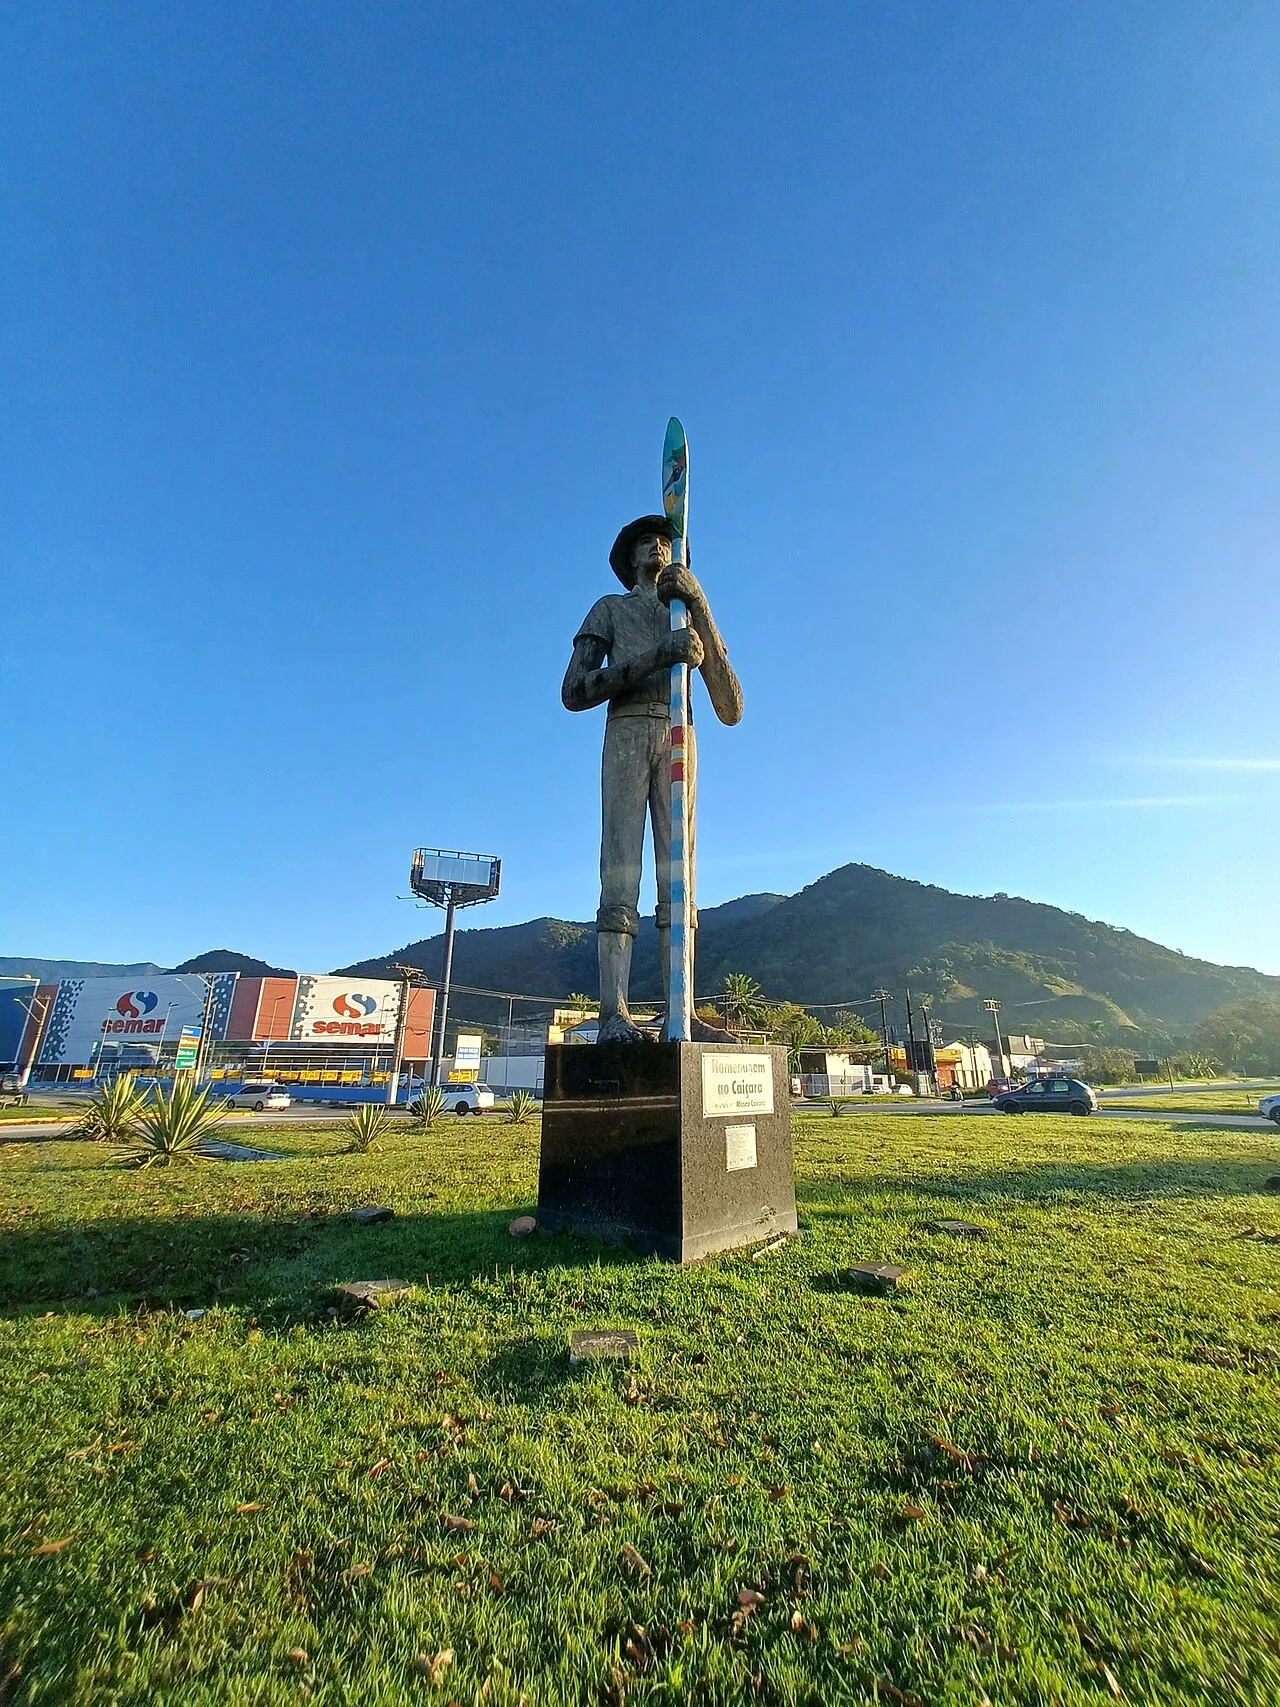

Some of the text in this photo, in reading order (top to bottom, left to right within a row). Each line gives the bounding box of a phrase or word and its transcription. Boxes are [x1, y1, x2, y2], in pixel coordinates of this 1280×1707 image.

[101, 1019, 166, 1033] semar
[312, 1021, 385, 1035] semar
[717, 1079, 763, 1099] ao Caiçara
